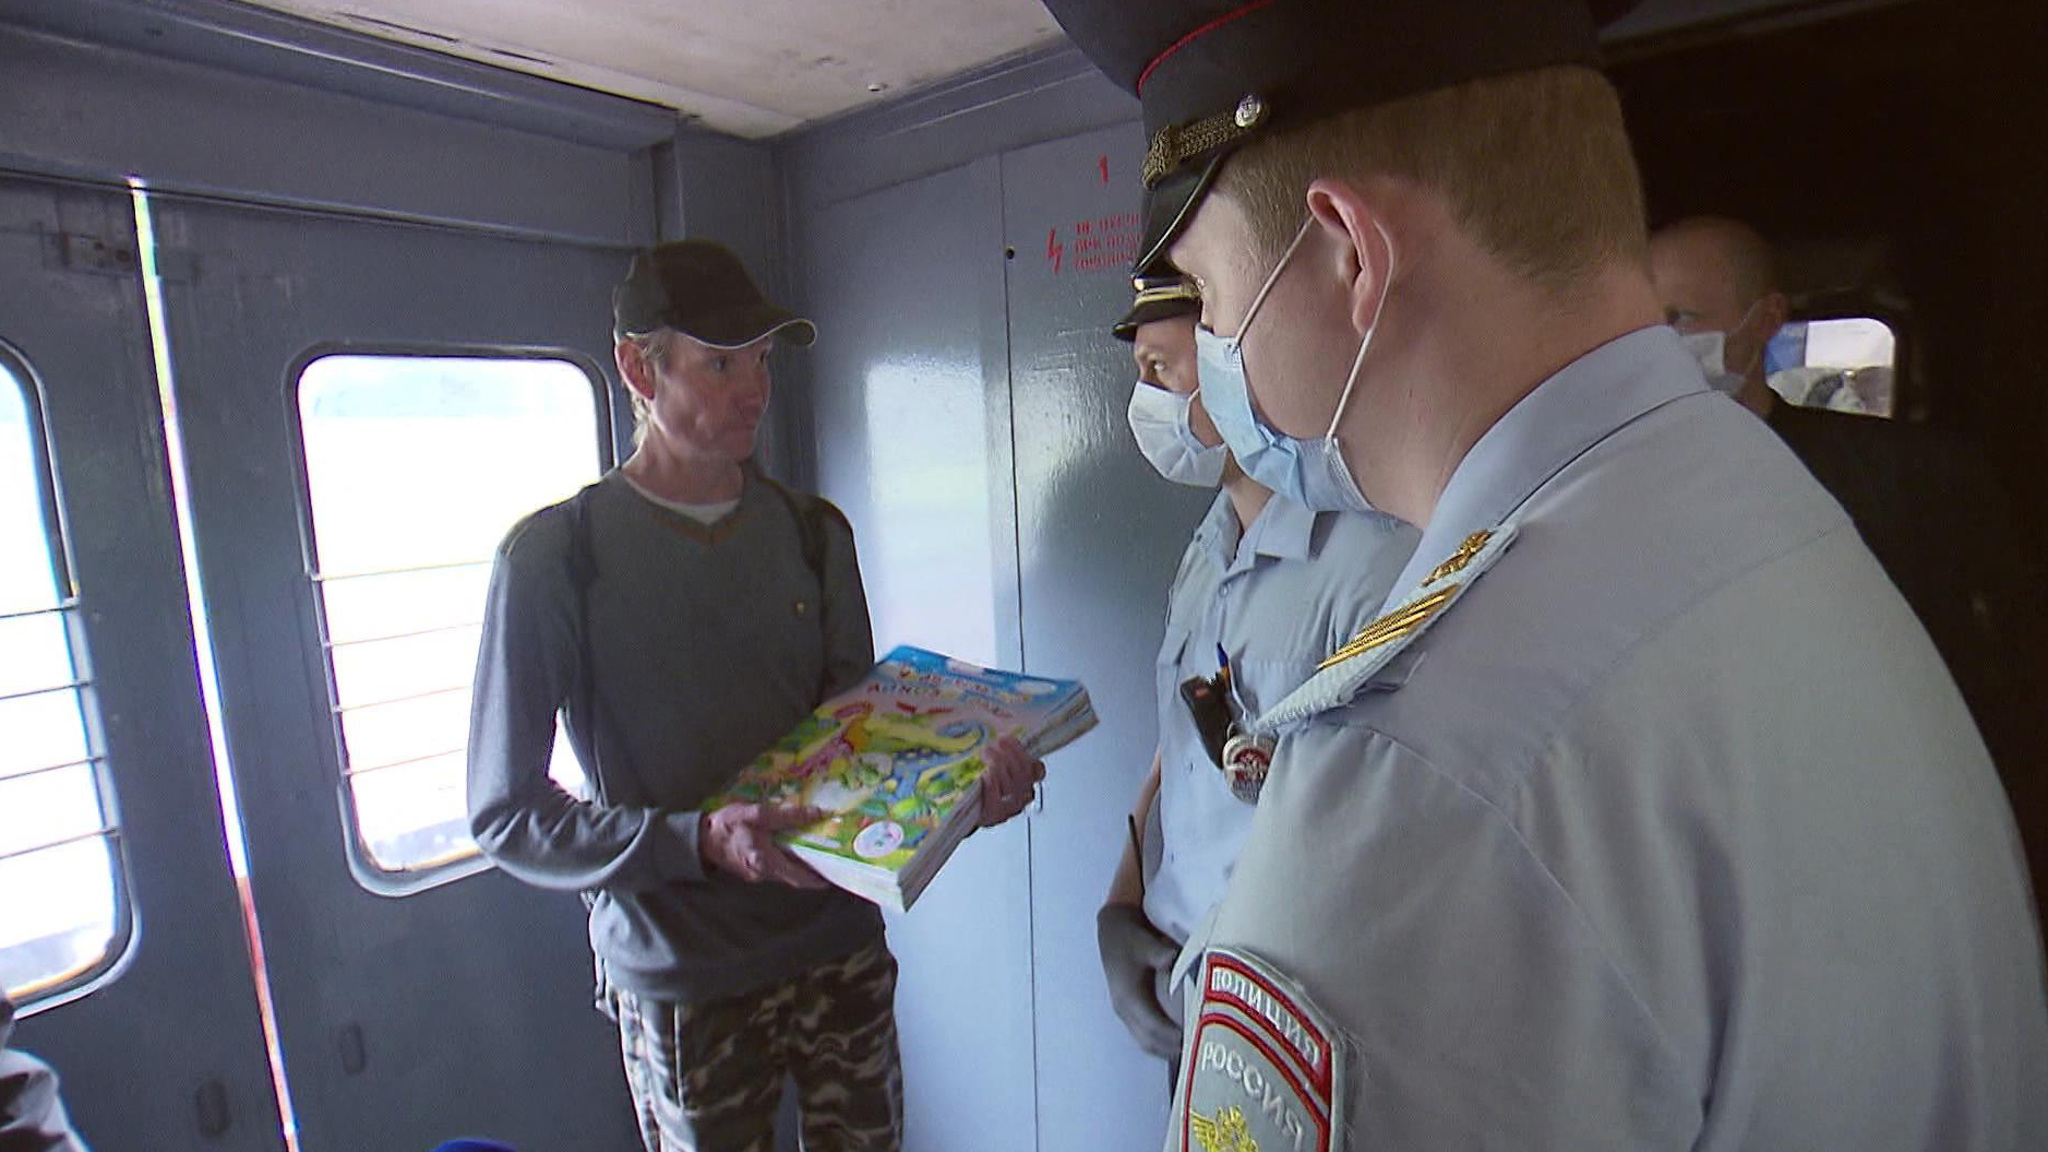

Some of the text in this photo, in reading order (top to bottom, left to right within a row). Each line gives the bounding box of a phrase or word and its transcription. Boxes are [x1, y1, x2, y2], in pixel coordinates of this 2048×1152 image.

[1097, 154, 1110, 182] 1
[1211, 966, 1321, 1067] ПОЛИЦИЯ
[1202, 1041, 1303, 1152] РОССИЯ
